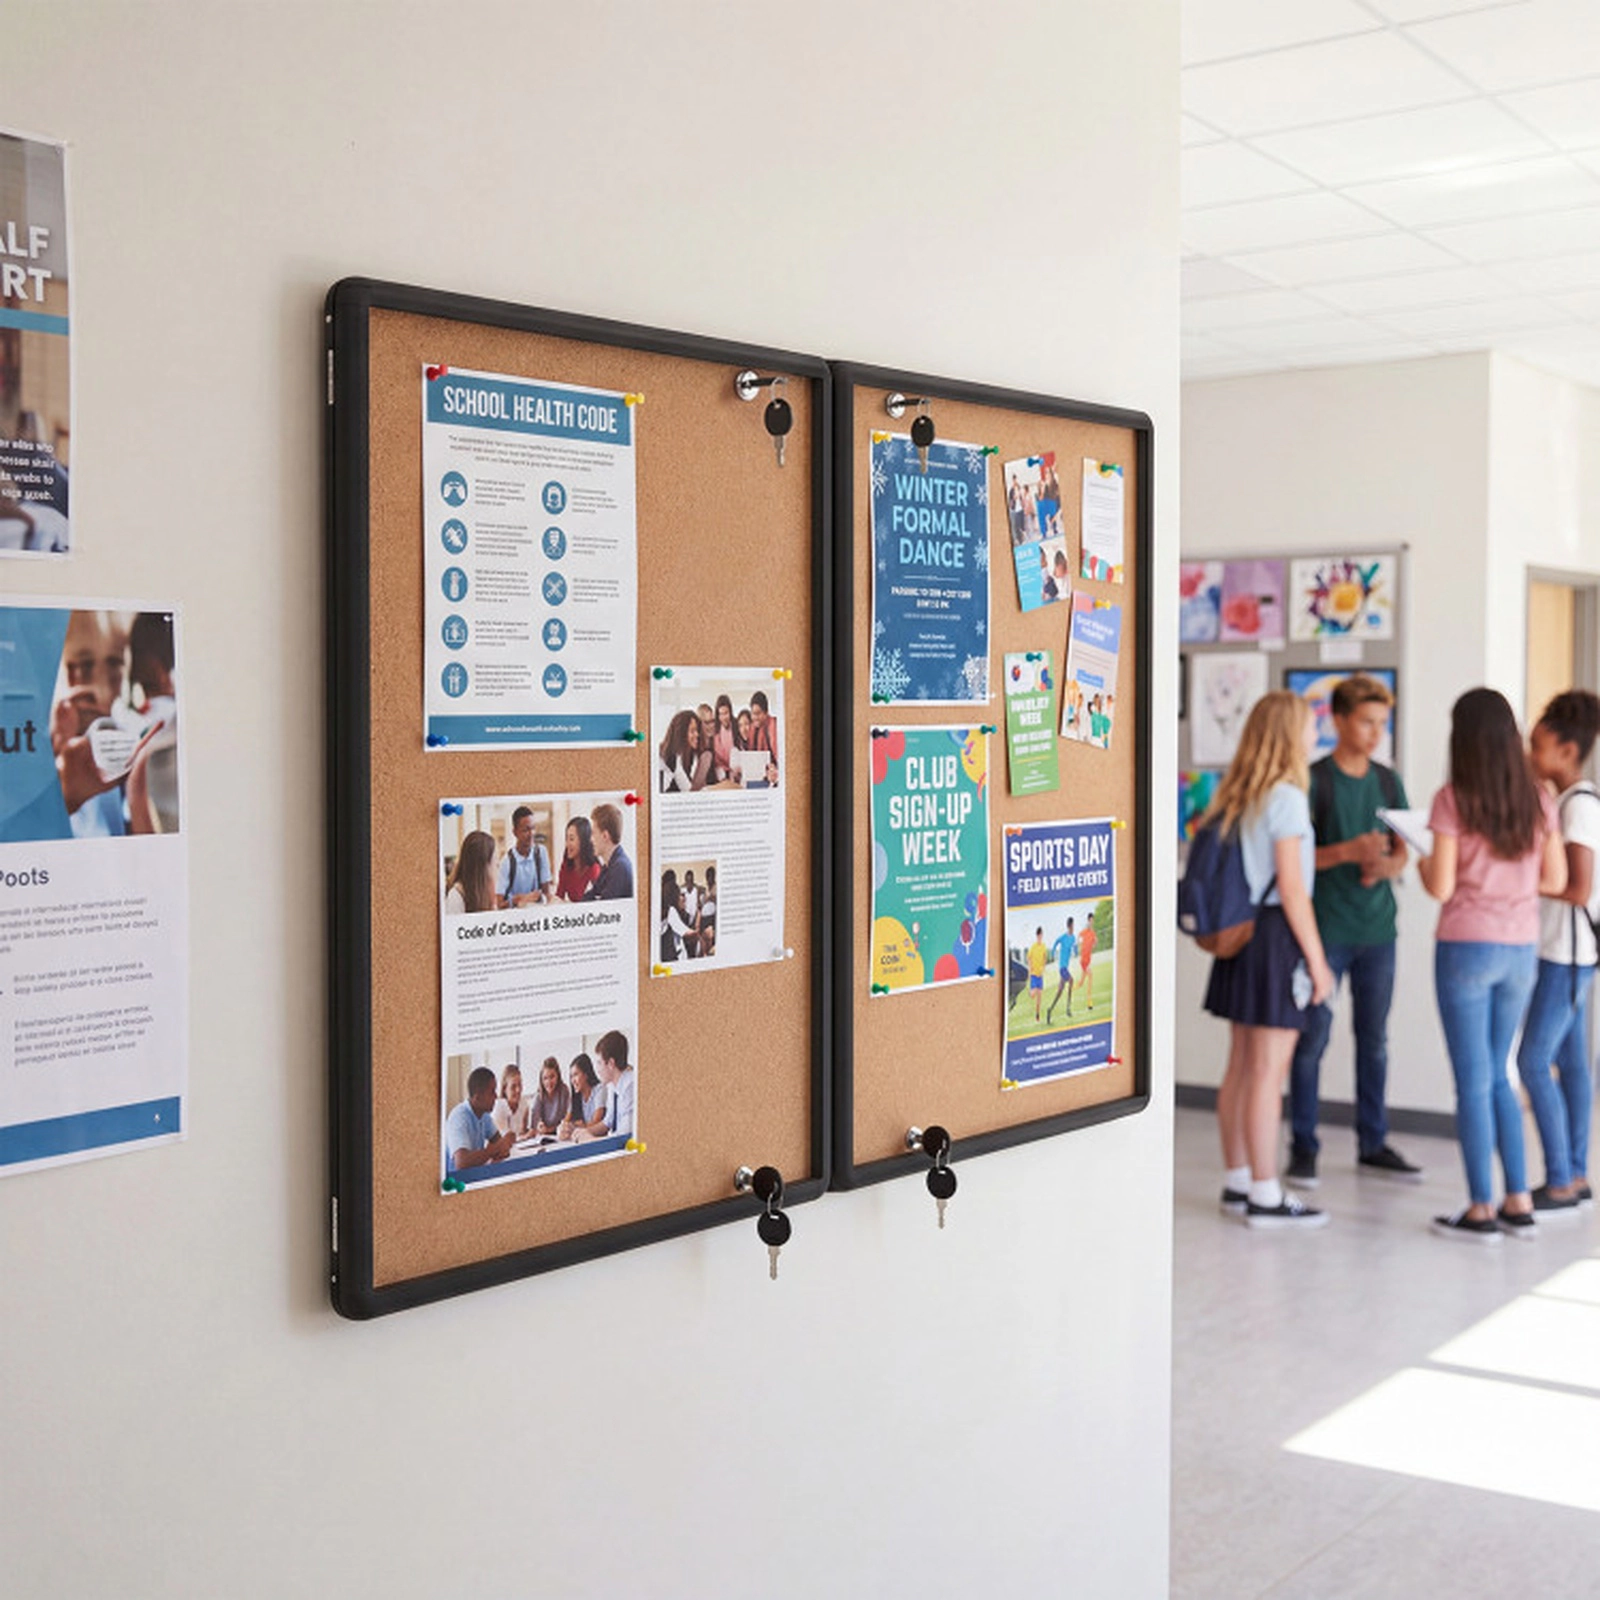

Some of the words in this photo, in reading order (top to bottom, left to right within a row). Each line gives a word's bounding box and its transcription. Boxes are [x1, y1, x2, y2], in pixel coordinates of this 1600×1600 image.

[443, 385, 510, 420] SCHOOL
[513, 394, 574, 428] HEALTH
[577, 403, 618, 434] CODE
[894, 473, 969, 507] WINTER
[892, 505, 971, 538] FORMAL
[899, 537, 965, 568] DANCE
[905, 754, 957, 790] CLUB
[889, 791, 972, 829] SIGN-UP
[902, 828, 961, 866] WEEK
[1010, 837, 1074, 873] SPORTS
[1079, 833, 1109, 867] DAY
[1017, 876, 1042, 894] FIELD
[1050, 873, 1076, 891] TRACK
[1077, 869, 1108, 888] EVENTS
[457, 926, 484, 940] Code
[486, 923, 498, 937] of
[498, 918, 541, 936] Conduct
[552, 912, 585, 930] School
